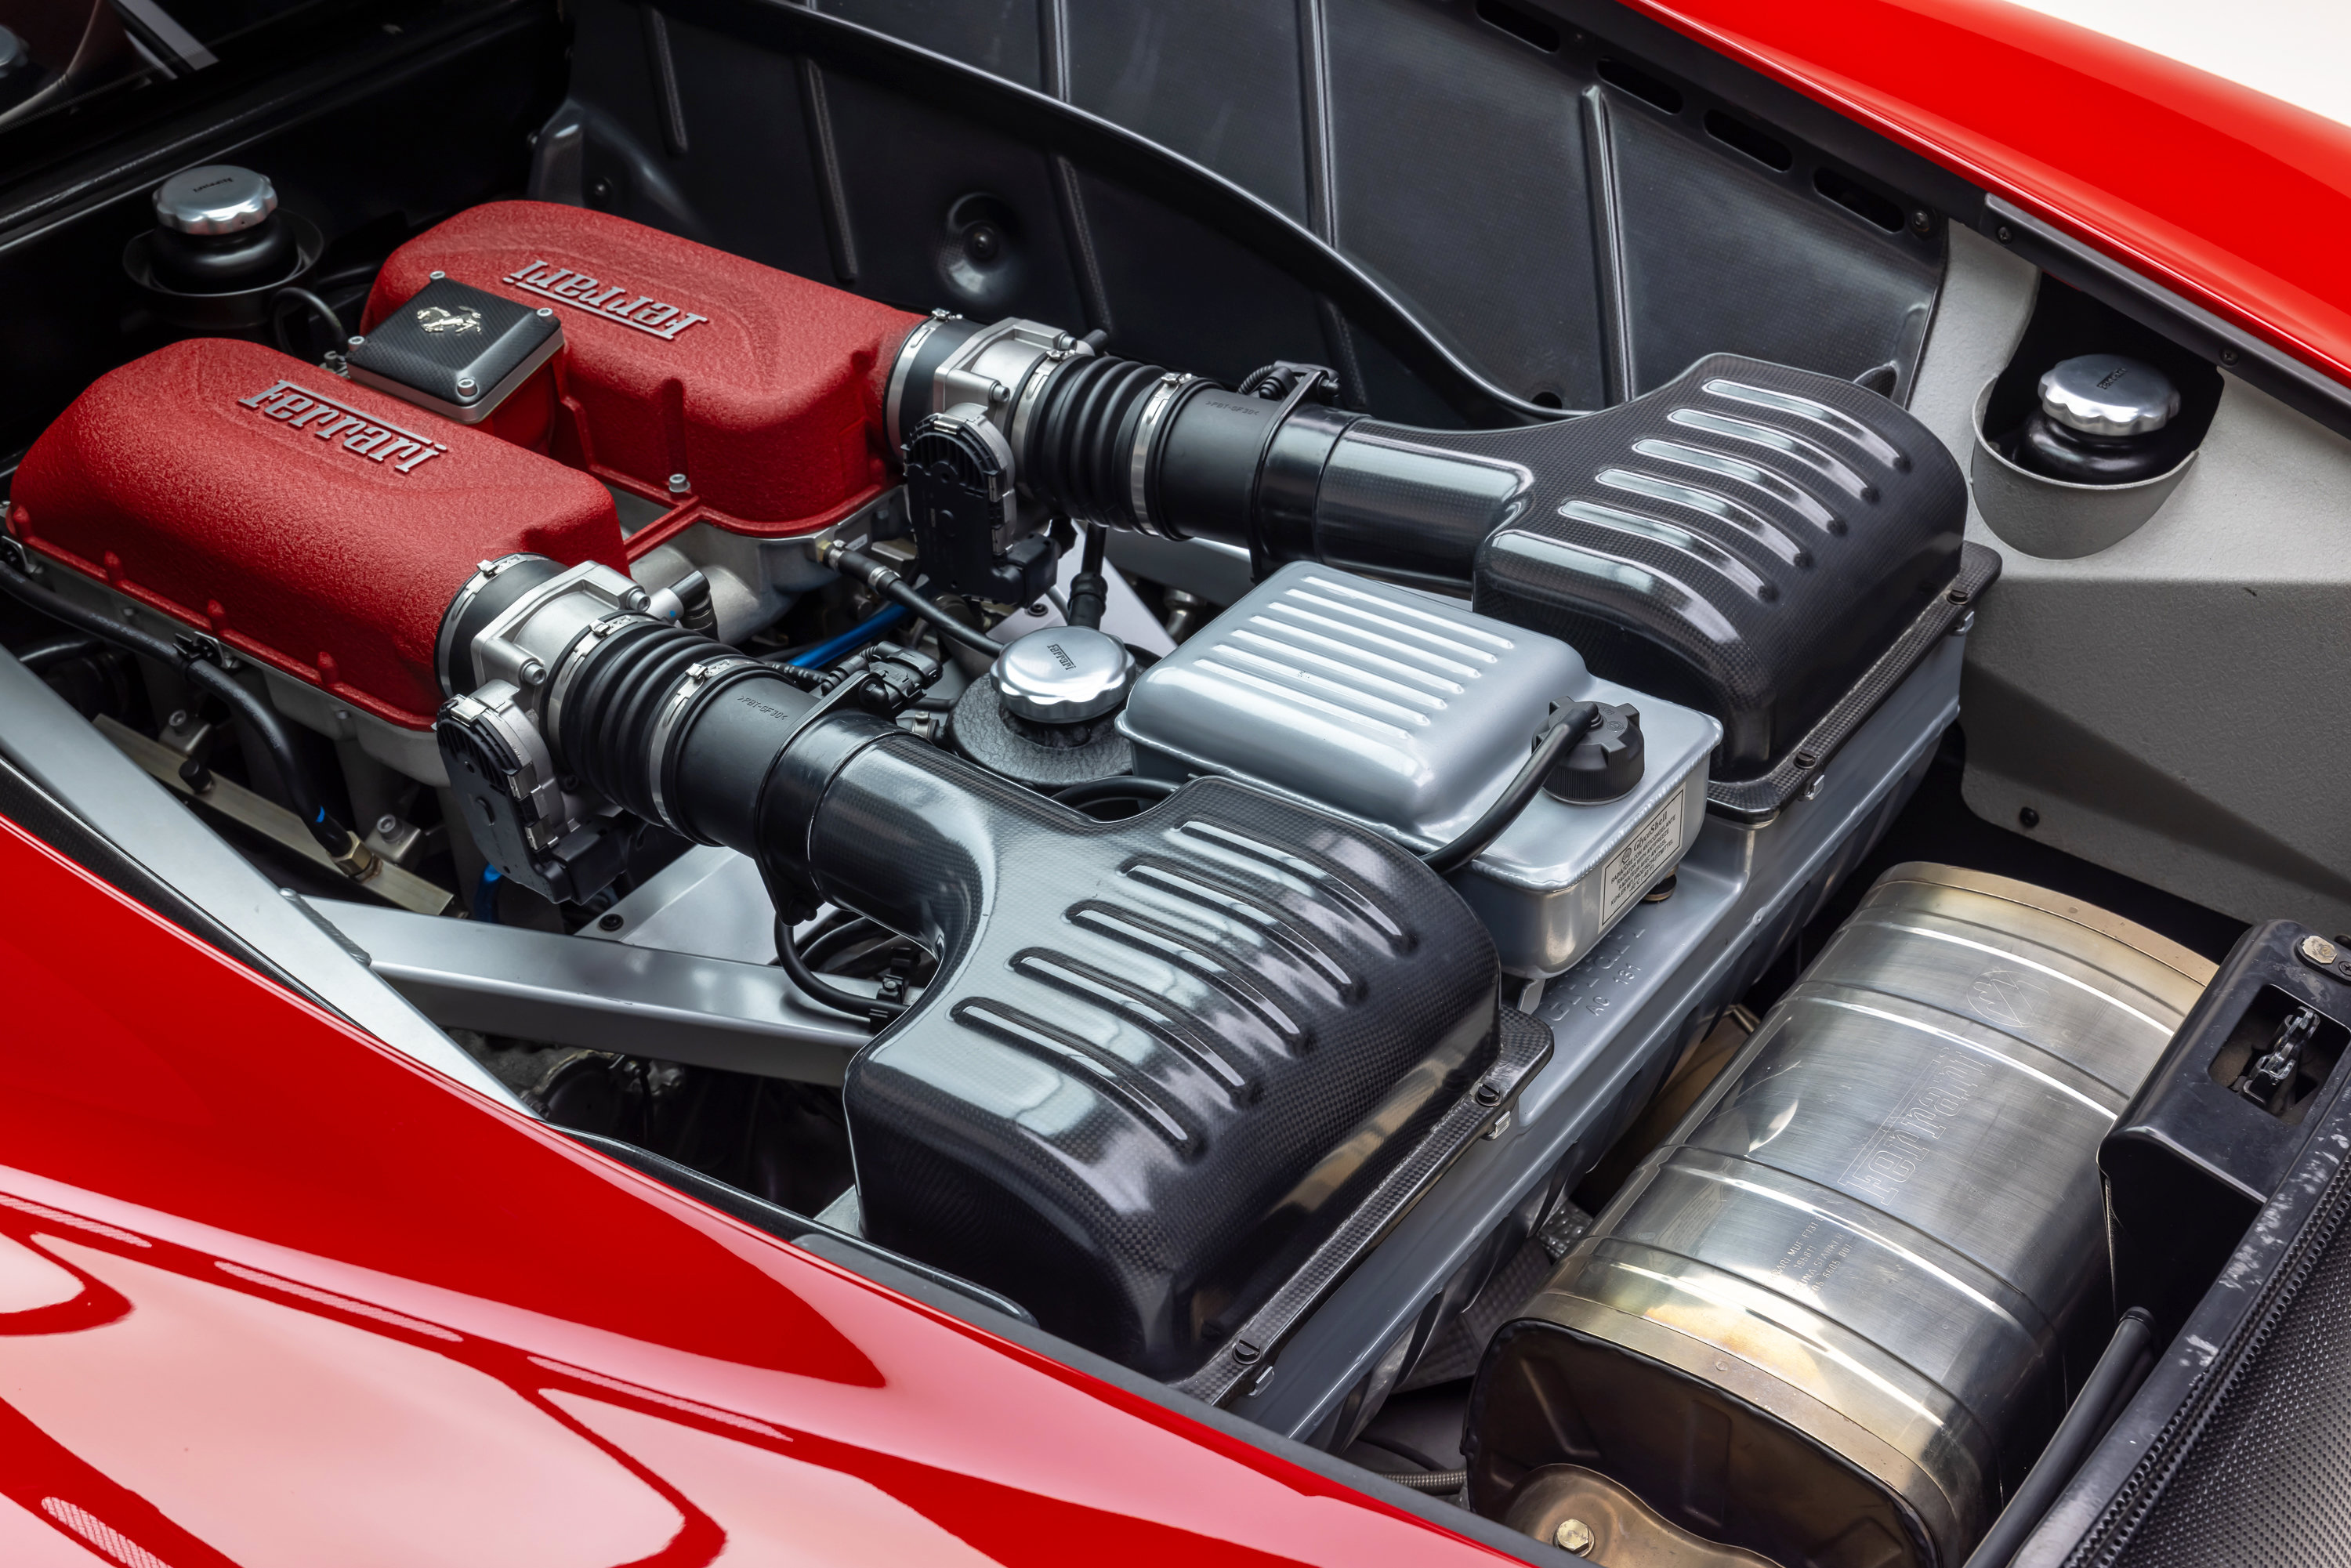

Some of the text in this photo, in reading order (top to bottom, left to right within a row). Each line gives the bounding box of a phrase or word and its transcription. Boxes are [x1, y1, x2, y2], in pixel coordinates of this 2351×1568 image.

[502, 259, 708, 340] Ferrari
[237, 379, 448, 473] Ferrari
[1047, 643, 1077, 671] Ferrari
[1610, 814, 1675, 884] RADIATORE CON ANTICONGELANTE
[1617, 827, 1669, 885] RADIATOR WITH ANTIFREEZE
[1633, 811, 1668, 851] GlycoShell
[1618, 865, 1639, 891] RADIATEUR
[1650, 838, 1667, 856] ANTIGEL
[1585, 962, 1642, 1016] AC 131
[1837, 1047, 1993, 1206] Ferrari
